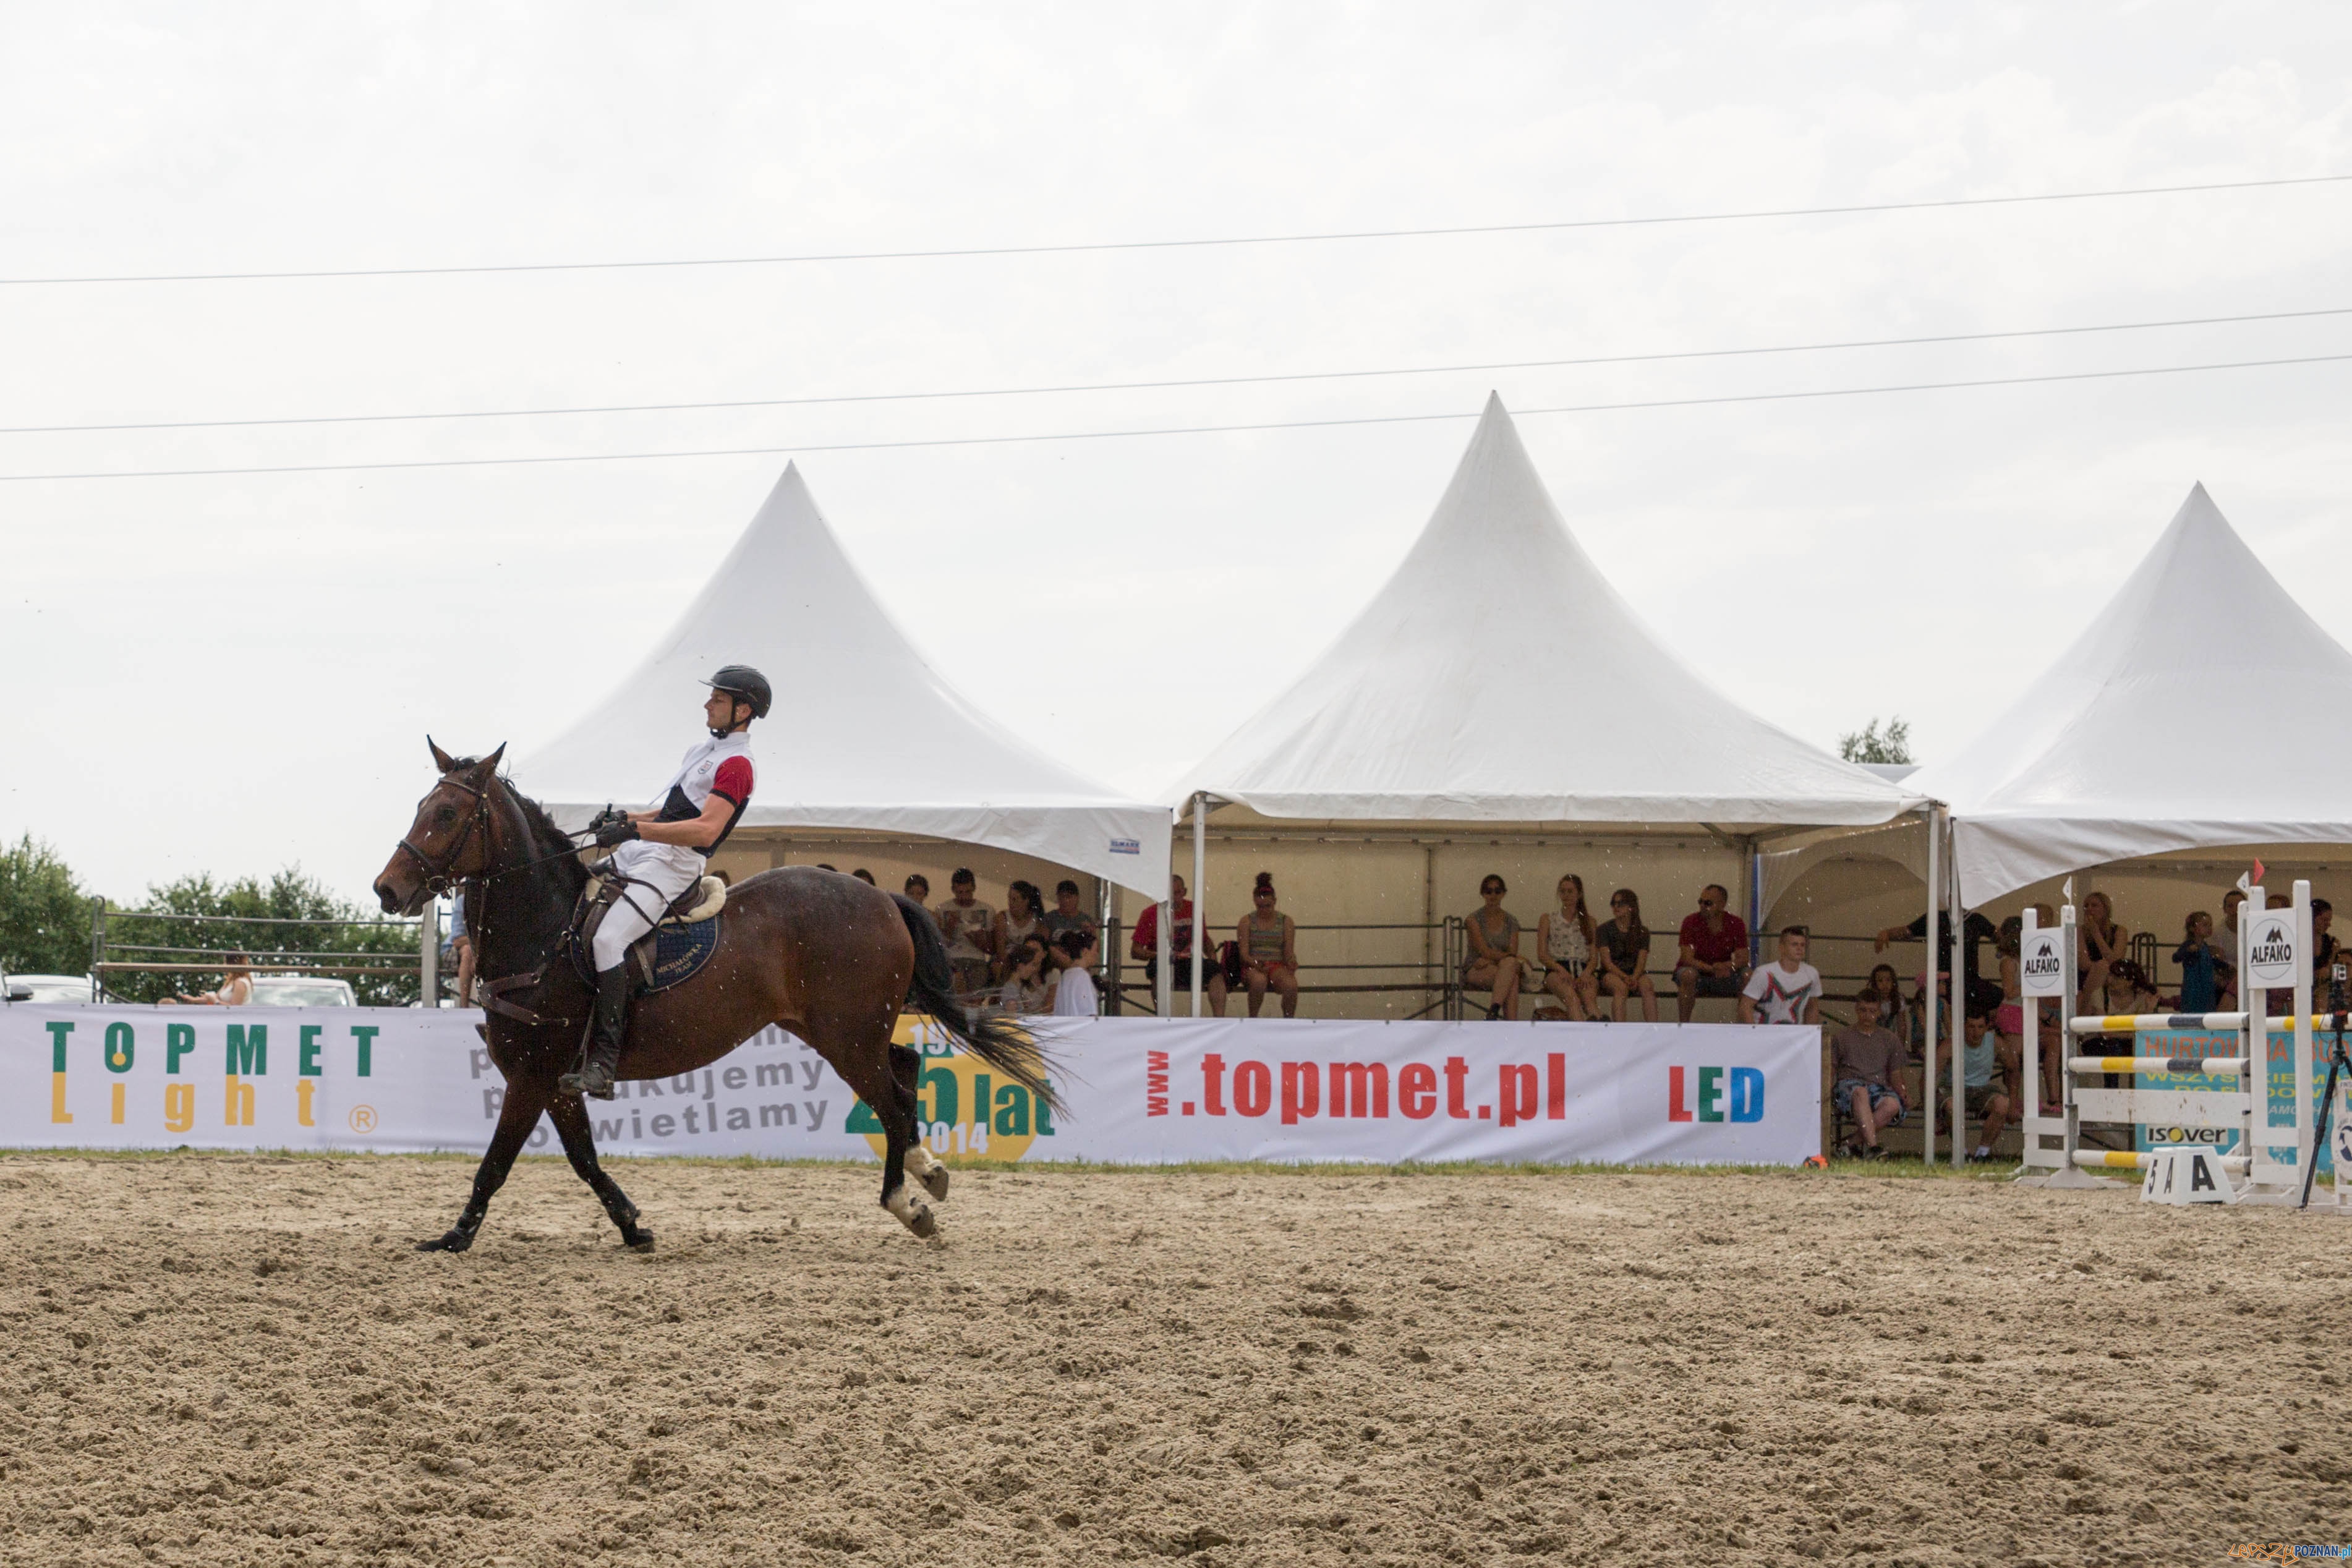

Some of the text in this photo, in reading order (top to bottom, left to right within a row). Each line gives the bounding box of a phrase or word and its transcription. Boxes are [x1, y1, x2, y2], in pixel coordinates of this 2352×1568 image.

[2024, 958, 2060, 974] ALFAKO
[2251, 943, 2292, 963] ALFAKO
[46, 1021, 380, 1077] TOPMET
[51, 1072, 317, 1133] Light
[974, 1073, 1055, 1137] lat
[1668, 1066, 1765, 1123] LED
[2191, 1154, 2217, 1192] A
